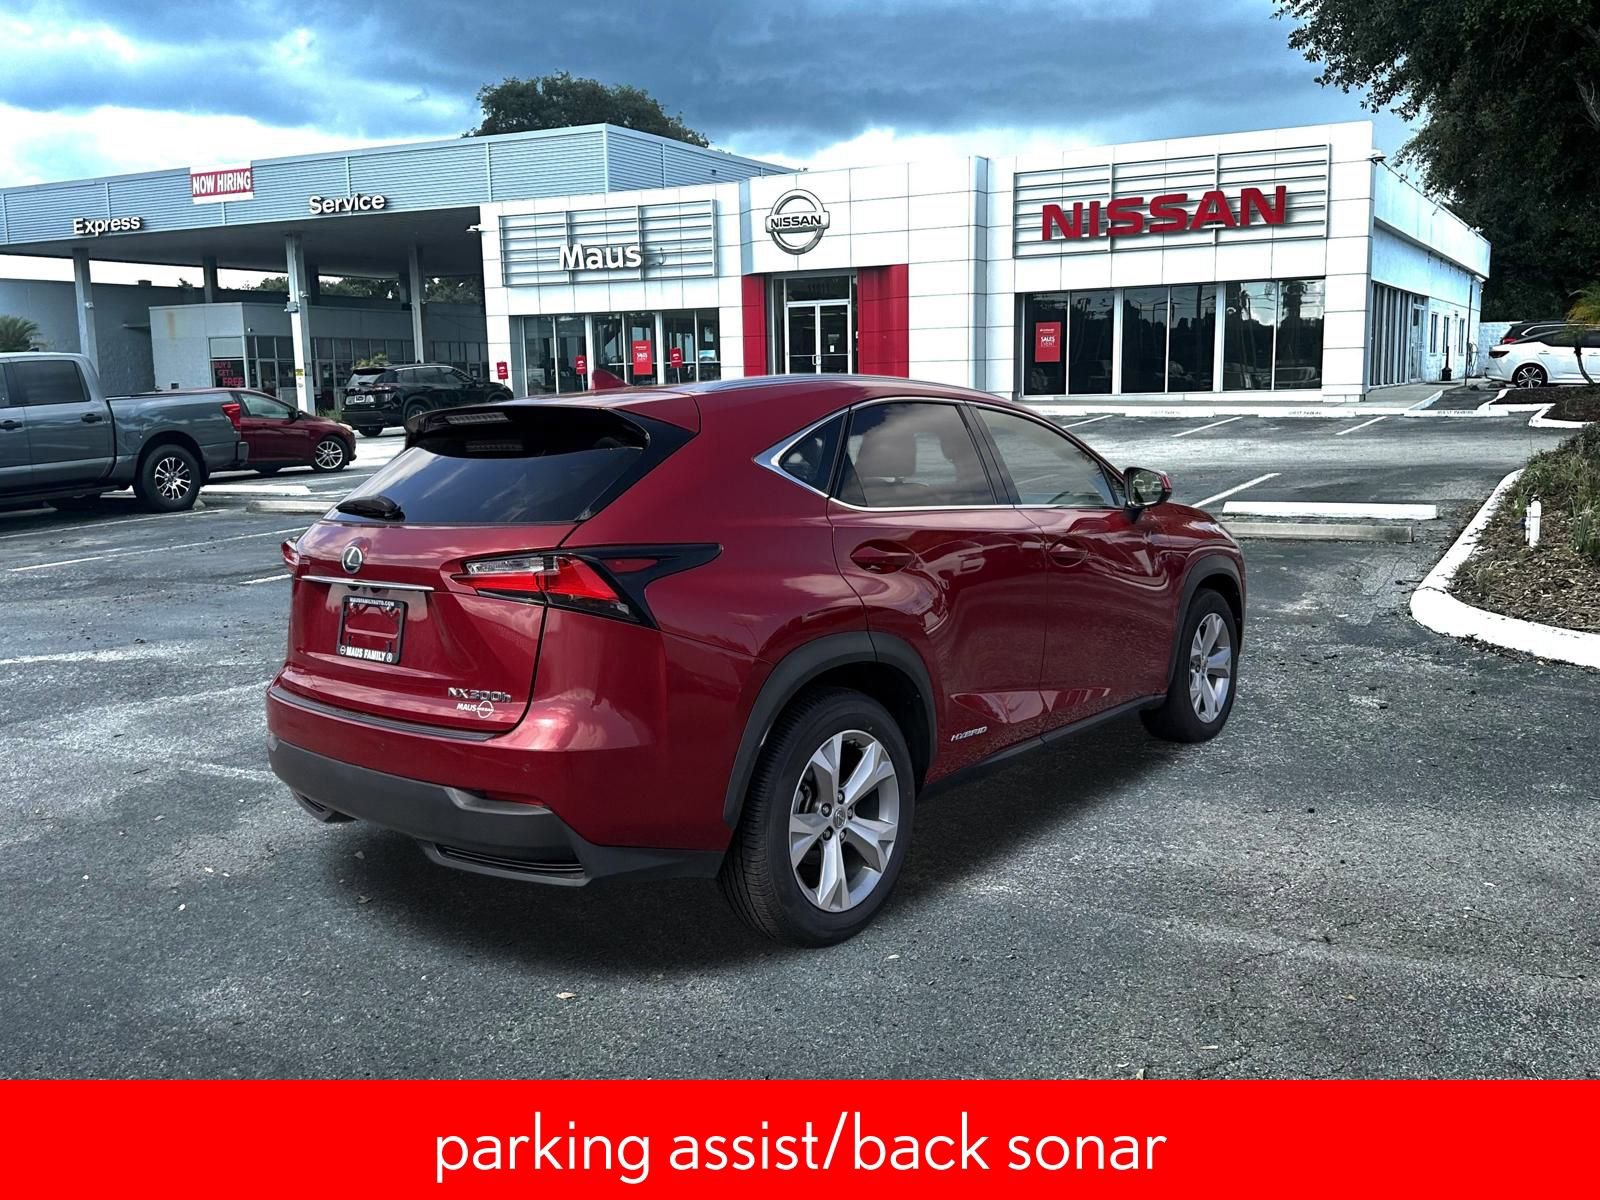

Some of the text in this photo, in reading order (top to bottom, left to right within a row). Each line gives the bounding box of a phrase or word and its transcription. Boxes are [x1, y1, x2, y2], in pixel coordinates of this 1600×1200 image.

[192, 170, 252, 195] NOW HIRING
[308, 193, 386, 216] Service
[1042, 185, 1287, 242] NISSAN
[72, 215, 142, 237] Express
[770, 215, 822, 229] NISSAN
[559, 242, 643, 272] Maus
[222, 377, 245, 387] FREE
[345, 646, 387, 661] MAUS FAMILY
[456, 703, 477, 712] MAUS
[950, 726, 988, 742] HYBRID
